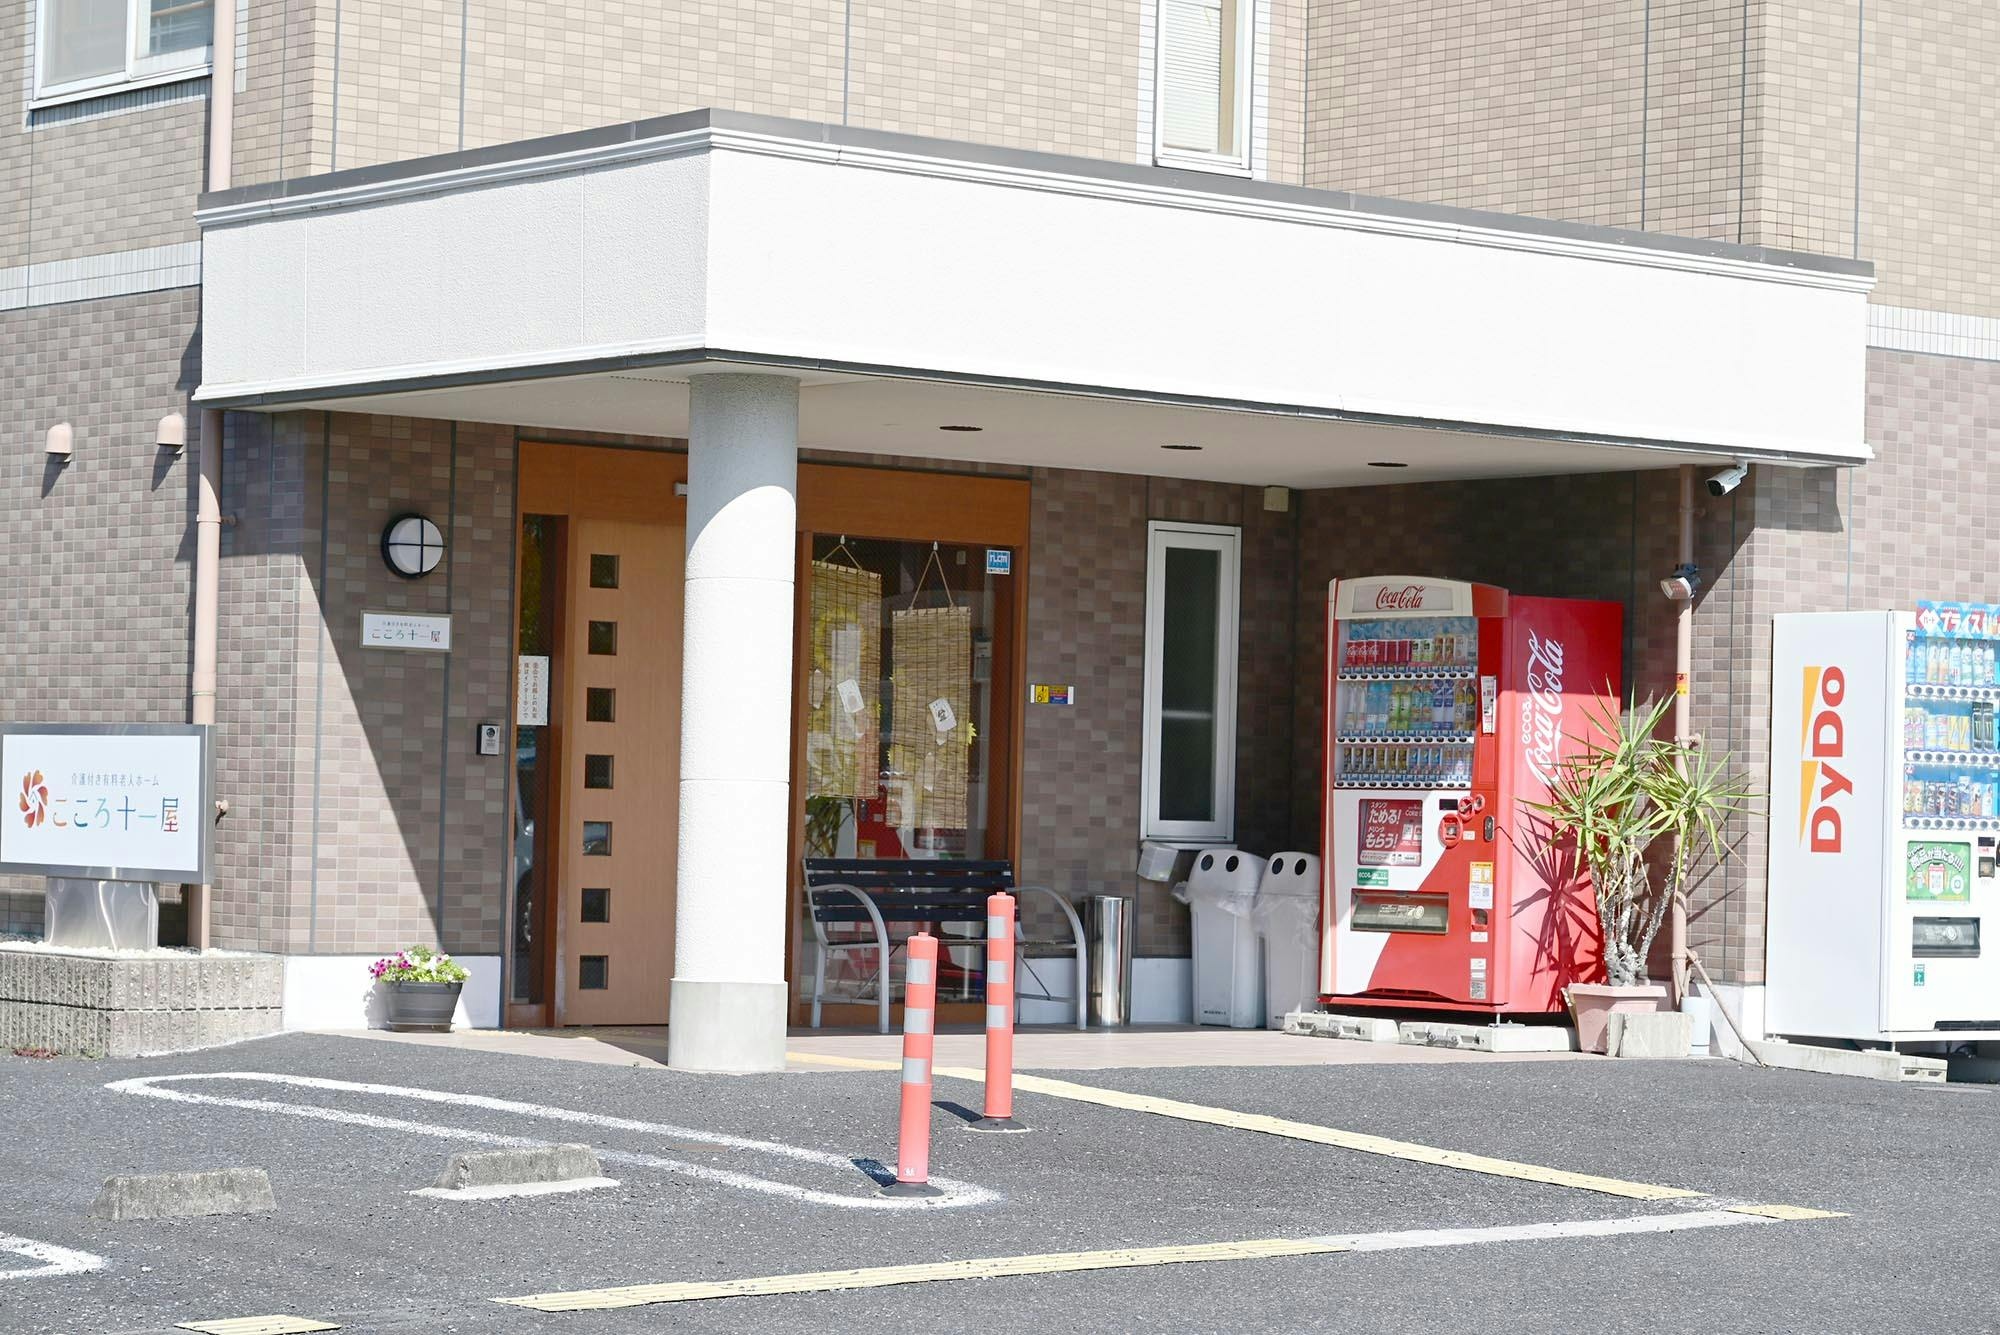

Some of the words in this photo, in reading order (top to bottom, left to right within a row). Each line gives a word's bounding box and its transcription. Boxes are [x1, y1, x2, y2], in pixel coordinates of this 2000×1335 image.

[1376, 585, 1426, 610] Coca-Cola
[1810, 666, 1853, 853] DyDo
[71, 772, 160, 787] 介護付き有料老人ホーム
[52, 795, 179, 832] こころ十一屋
